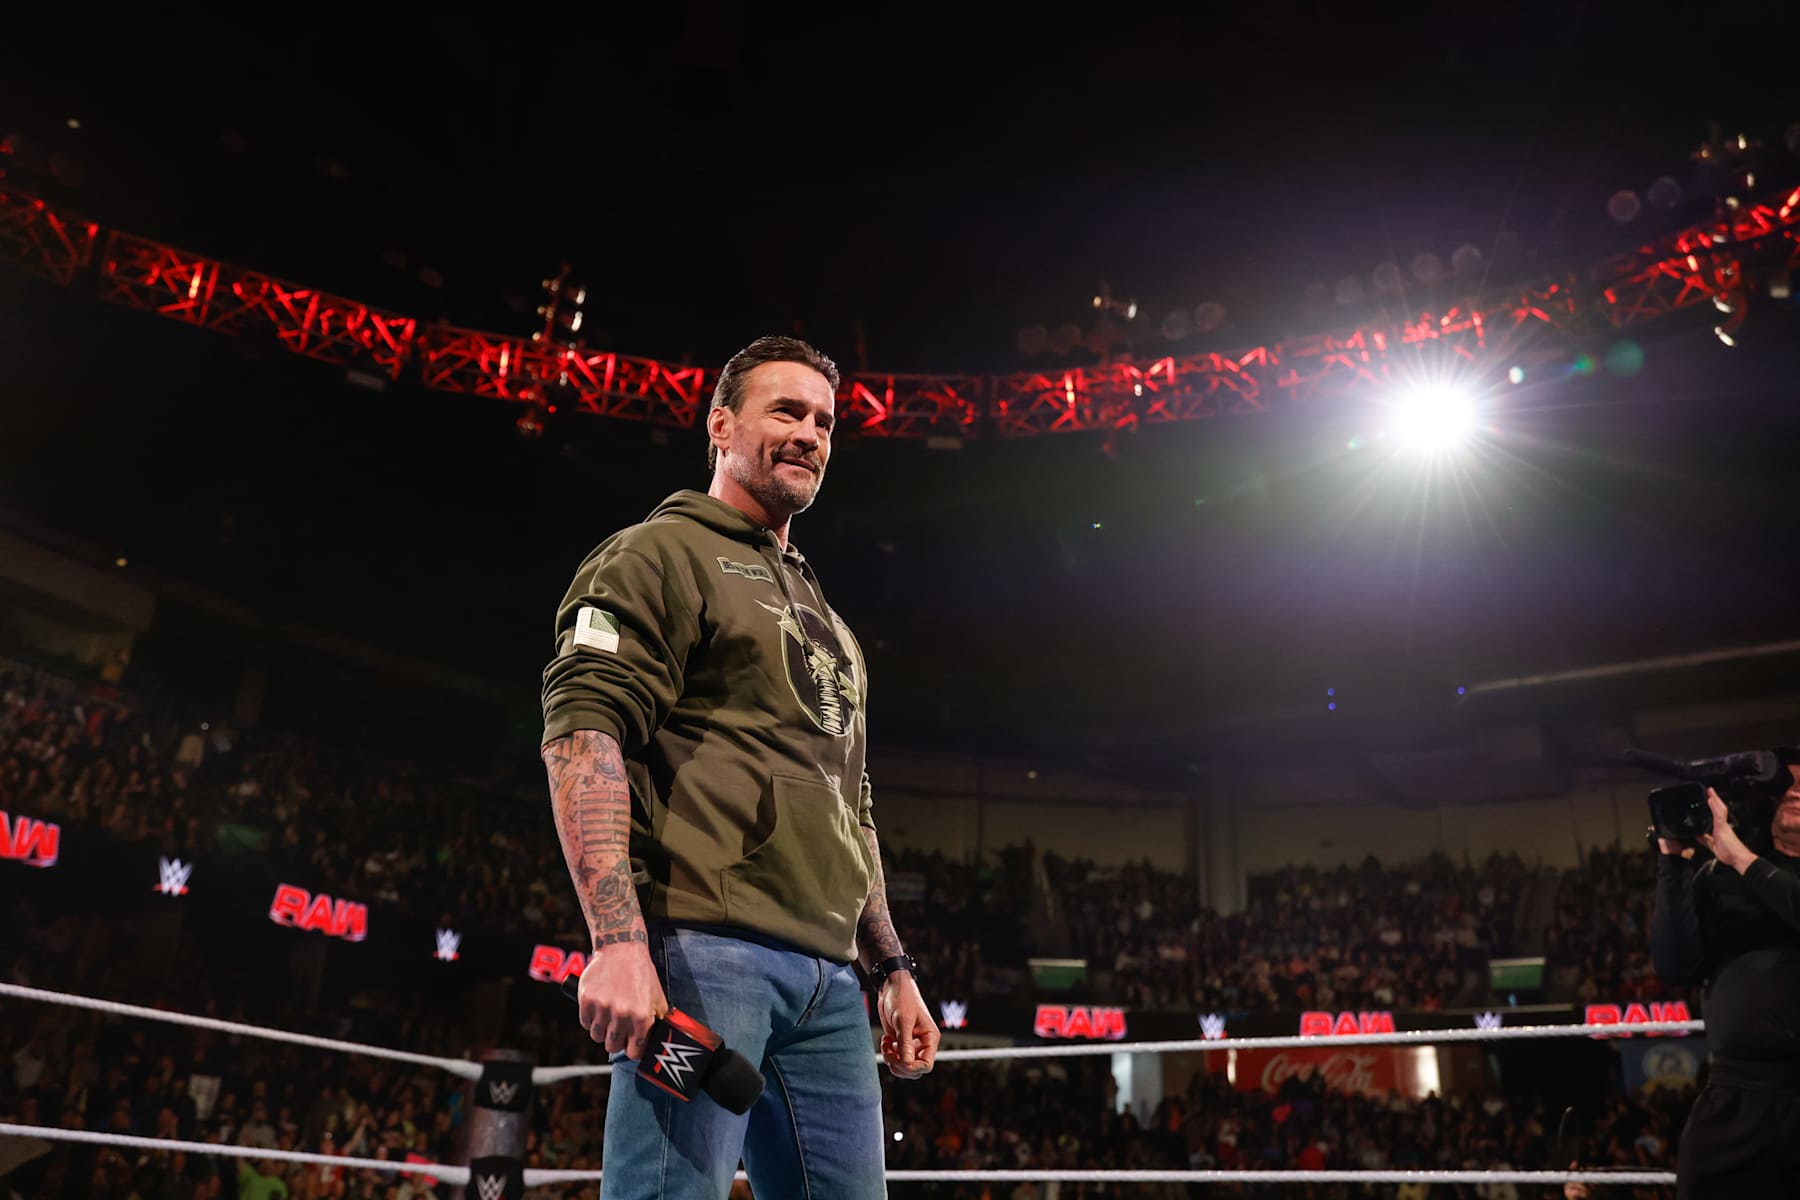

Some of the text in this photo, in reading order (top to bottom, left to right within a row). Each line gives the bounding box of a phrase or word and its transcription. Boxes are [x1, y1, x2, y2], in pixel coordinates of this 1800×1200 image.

[269, 883, 368, 942] RAW
[529, 944, 593, 984] RA
[1034, 1004, 1127, 1040] RAW
